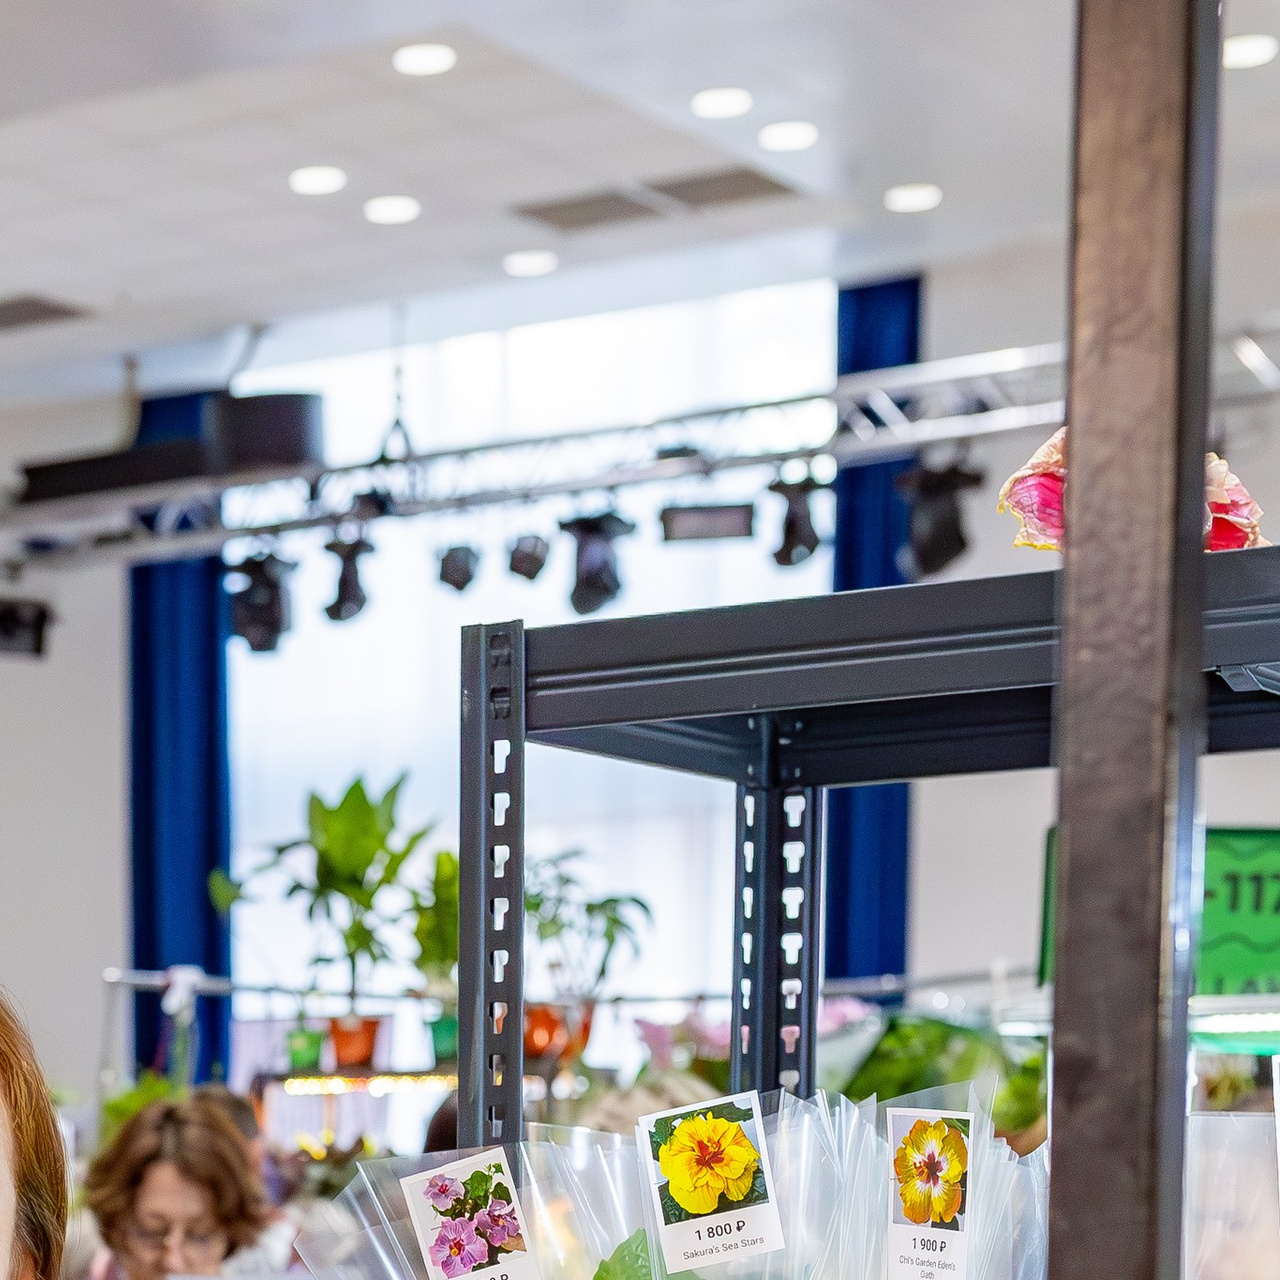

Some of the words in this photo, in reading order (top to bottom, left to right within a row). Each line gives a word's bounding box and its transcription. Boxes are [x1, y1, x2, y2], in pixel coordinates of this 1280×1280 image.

[694, 1229, 702, 1241] 1
[706, 1222, 732, 1239] 800
[736, 1219, 746, 1232] ₽
[683, 1245, 720, 1260] Sakura's
[721, 1241, 739, 1252] Sea
[740, 1236, 765, 1248] Stars
[912, 1237, 917, 1250] 1
[920, 1238, 937, 1252] 900
[939, 1240, 947, 1253] ₽
[914, 1257, 937, 1269] Garden
[920, 1269, 935, 1280] Oath
